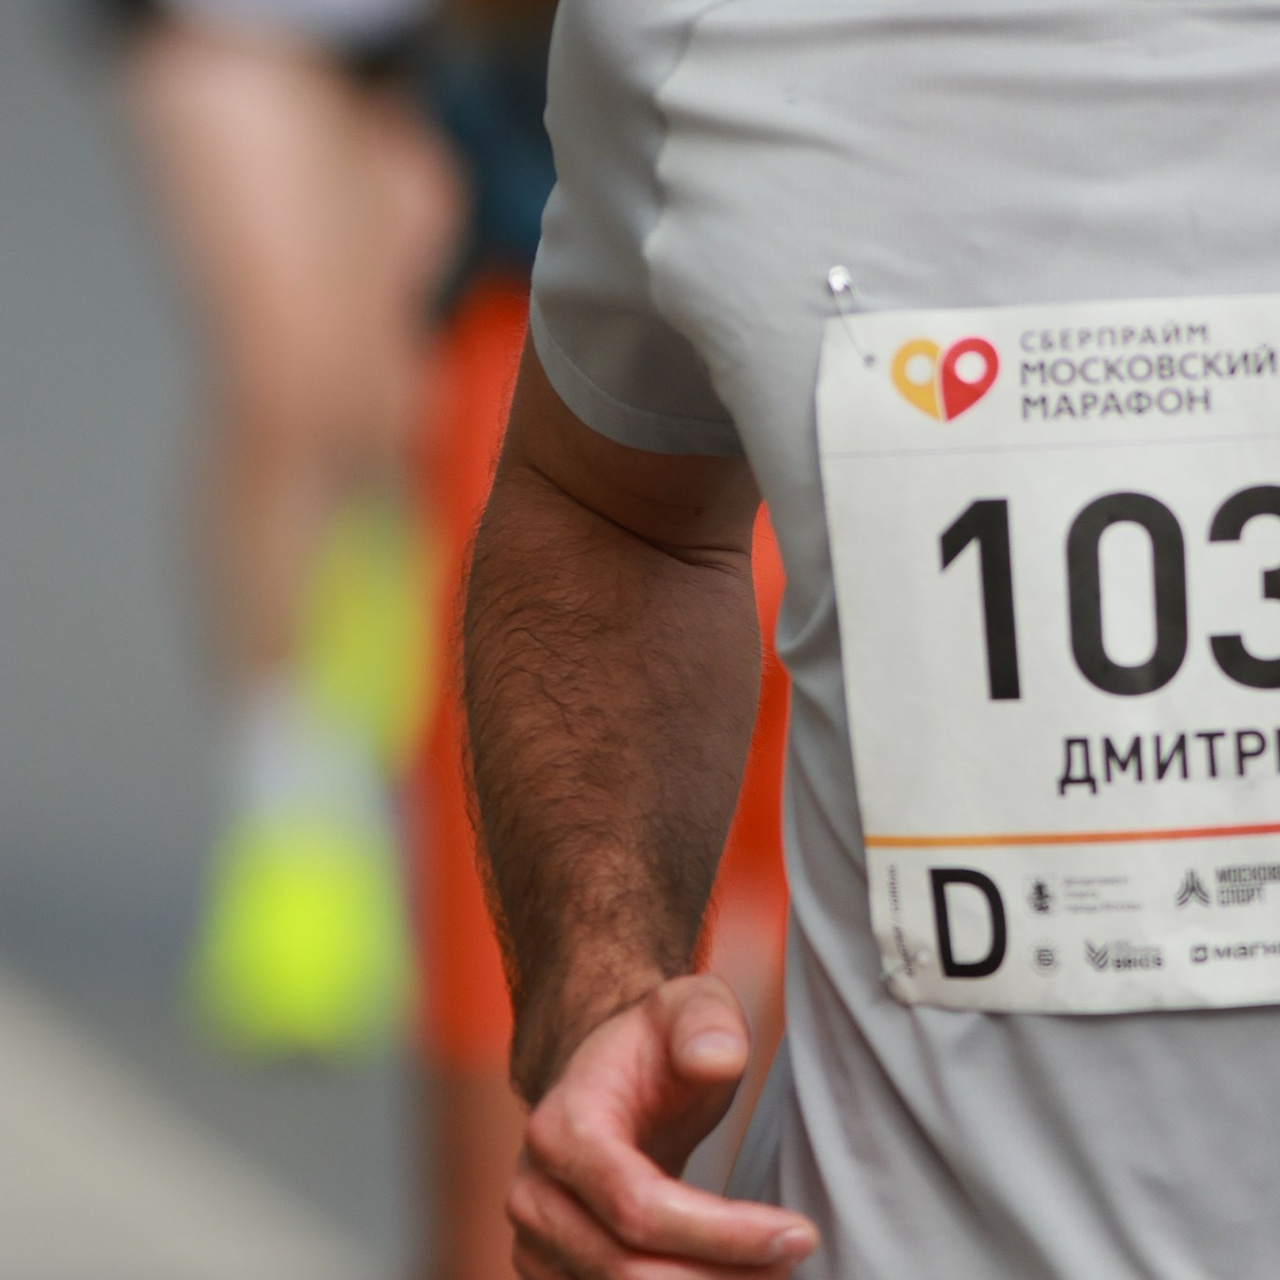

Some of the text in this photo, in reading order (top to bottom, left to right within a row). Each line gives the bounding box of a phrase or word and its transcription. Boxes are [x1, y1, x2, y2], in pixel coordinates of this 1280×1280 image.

[1020, 320, 1209, 351] СБЕРПРАЙМ
[1020, 345, 1278, 386] МОСКОВСКИЙ
[1021, 387, 1212, 421] МАРАФОН
[928, 867, 1008, 980] D
